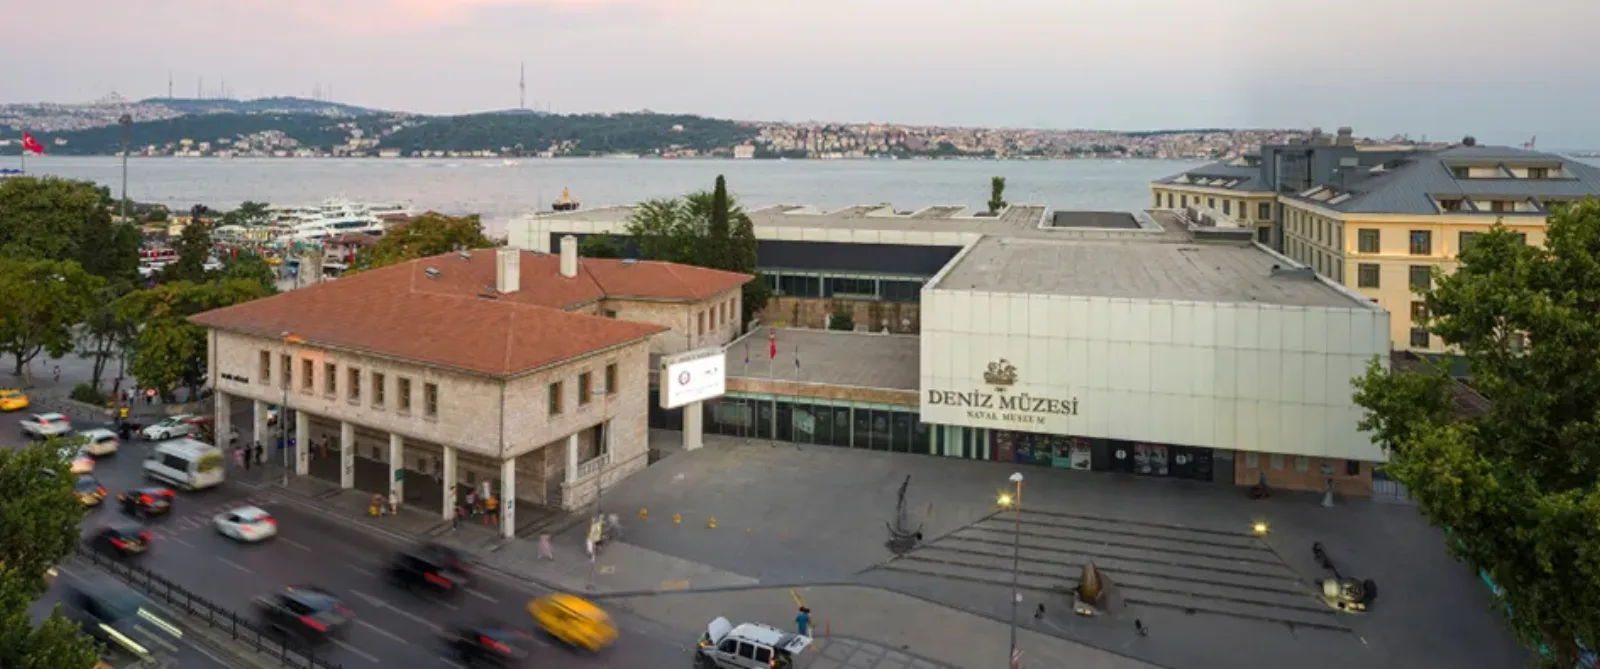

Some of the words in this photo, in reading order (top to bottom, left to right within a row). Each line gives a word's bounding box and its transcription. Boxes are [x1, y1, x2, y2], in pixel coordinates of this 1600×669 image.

[928, 389, 993, 409] DENİZ
[999, 392, 1079, 415] MÜZESİ
[967, 410, 998, 421] NAVAL
[1002, 412, 1045, 424] MUSEUM
